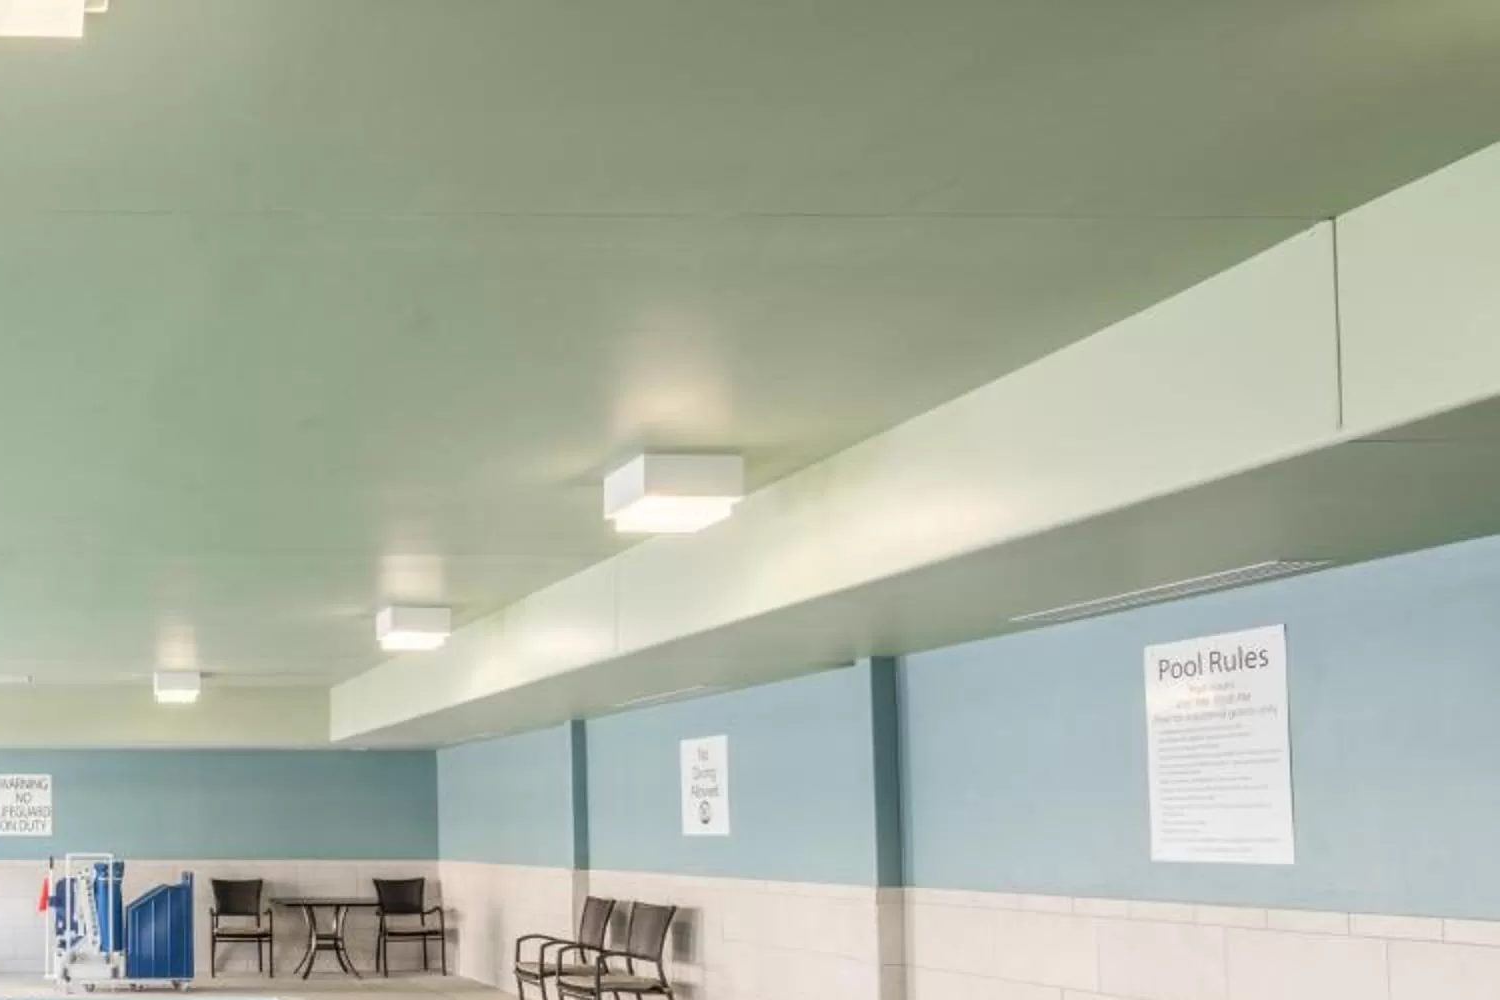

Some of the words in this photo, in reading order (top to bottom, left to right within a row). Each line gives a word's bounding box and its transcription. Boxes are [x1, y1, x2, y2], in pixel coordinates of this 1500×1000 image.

[1158, 650, 1203, 681] Pool
[1209, 645, 1270, 674] Rules
[0, 777, 49, 791] WARNING
[15, 791, 33, 804] NO
[0, 819, 17, 832] ON
[19, 819, 49, 833] DUTY
